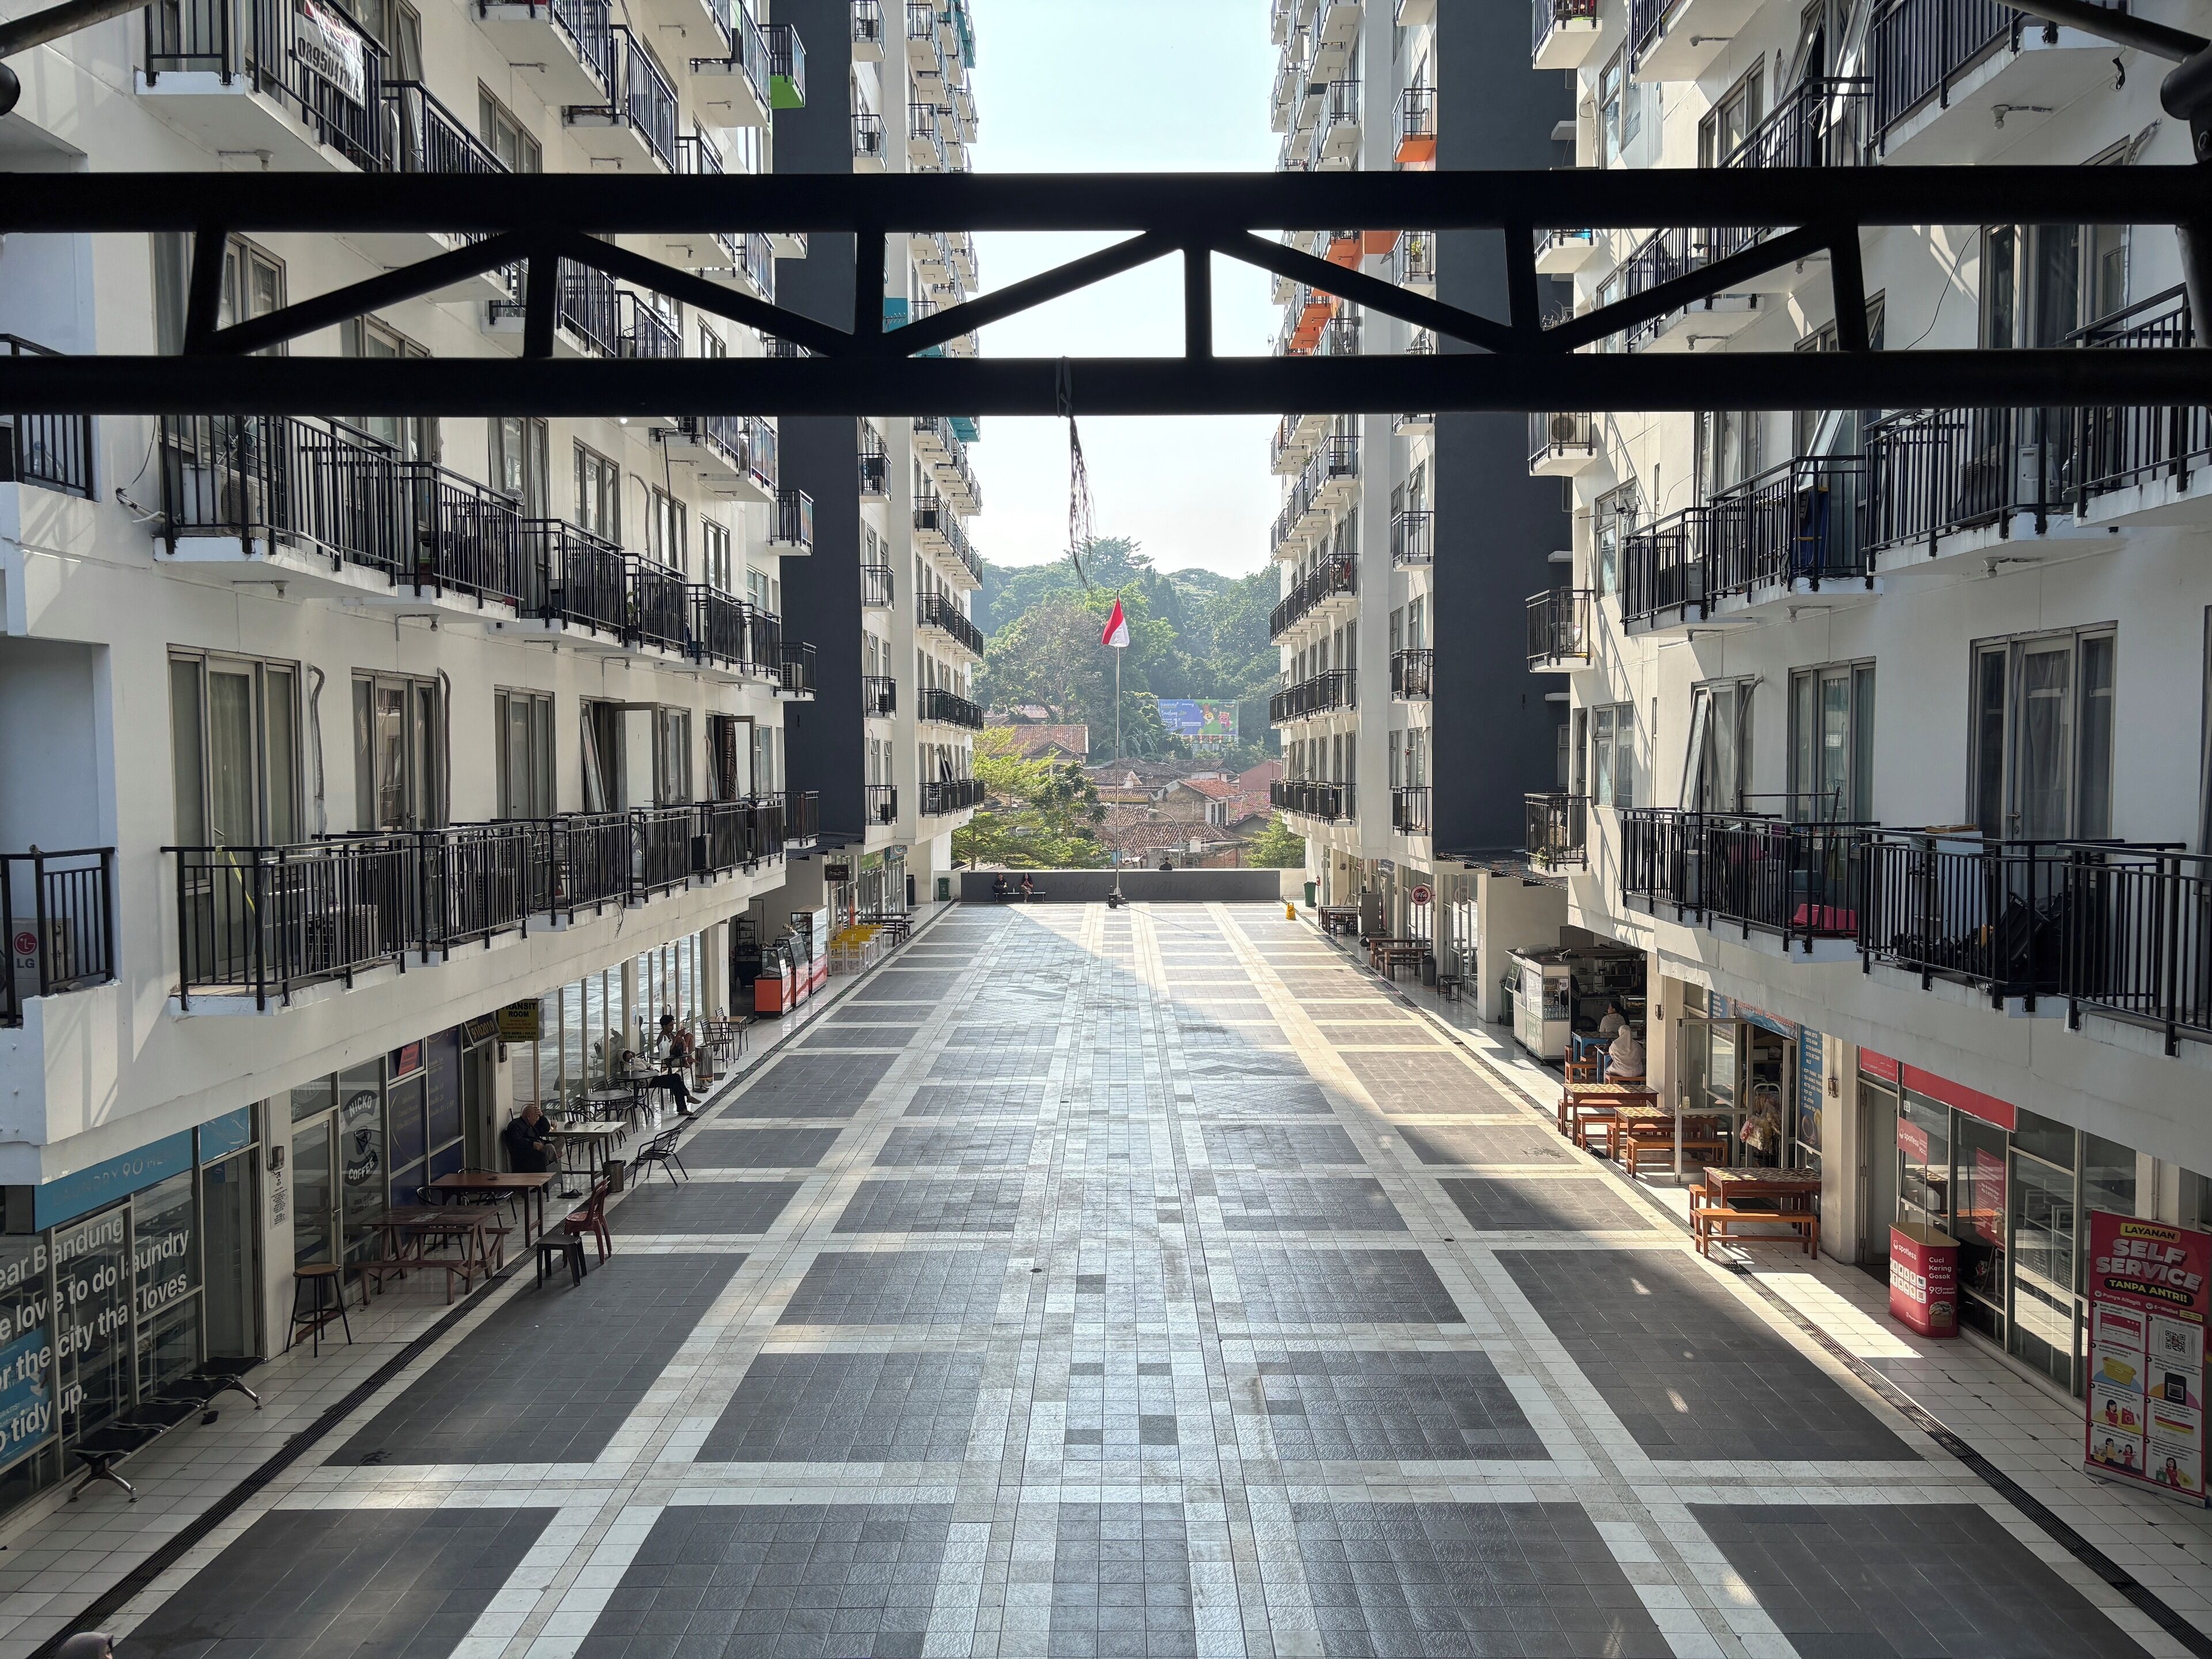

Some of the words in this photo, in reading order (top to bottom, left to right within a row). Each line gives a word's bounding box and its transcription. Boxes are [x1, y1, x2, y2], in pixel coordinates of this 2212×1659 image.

[16, 958, 35, 969] LG
[502, 1002, 537, 1010] RANSIT
[471, 1020, 495, 1040] 9102019
[349, 1094, 372, 1118] NICKO
[1904, 1131, 1919, 1147] spotless
[349, 1156, 375, 1180] COFFEE
[33, 1215, 124, 1274] Bandung
[2124, 1225, 2176, 1240] LAYANAN
[1899, 1244, 1917, 1260] spotless
[2112, 1238, 2187, 1264] SELF
[16, 1290, 64, 1332] love
[67, 1279, 89, 1305] to
[92, 1264, 117, 1293] do
[121, 1229, 190, 1281] laundry
[2096, 1256, 2203, 1291] SERVICE
[2109, 1279, 2147, 1293] TANPA
[2149, 1286, 2188, 1304] ANTRI!
[16, 1346, 51, 1381] the
[58, 1321, 94, 1358] city
[97, 1295, 139, 1336] that
[143, 1273, 187, 1313] loves
[11, 1400, 52, 1442] tidy
[58, 1384, 88, 1415] up.
